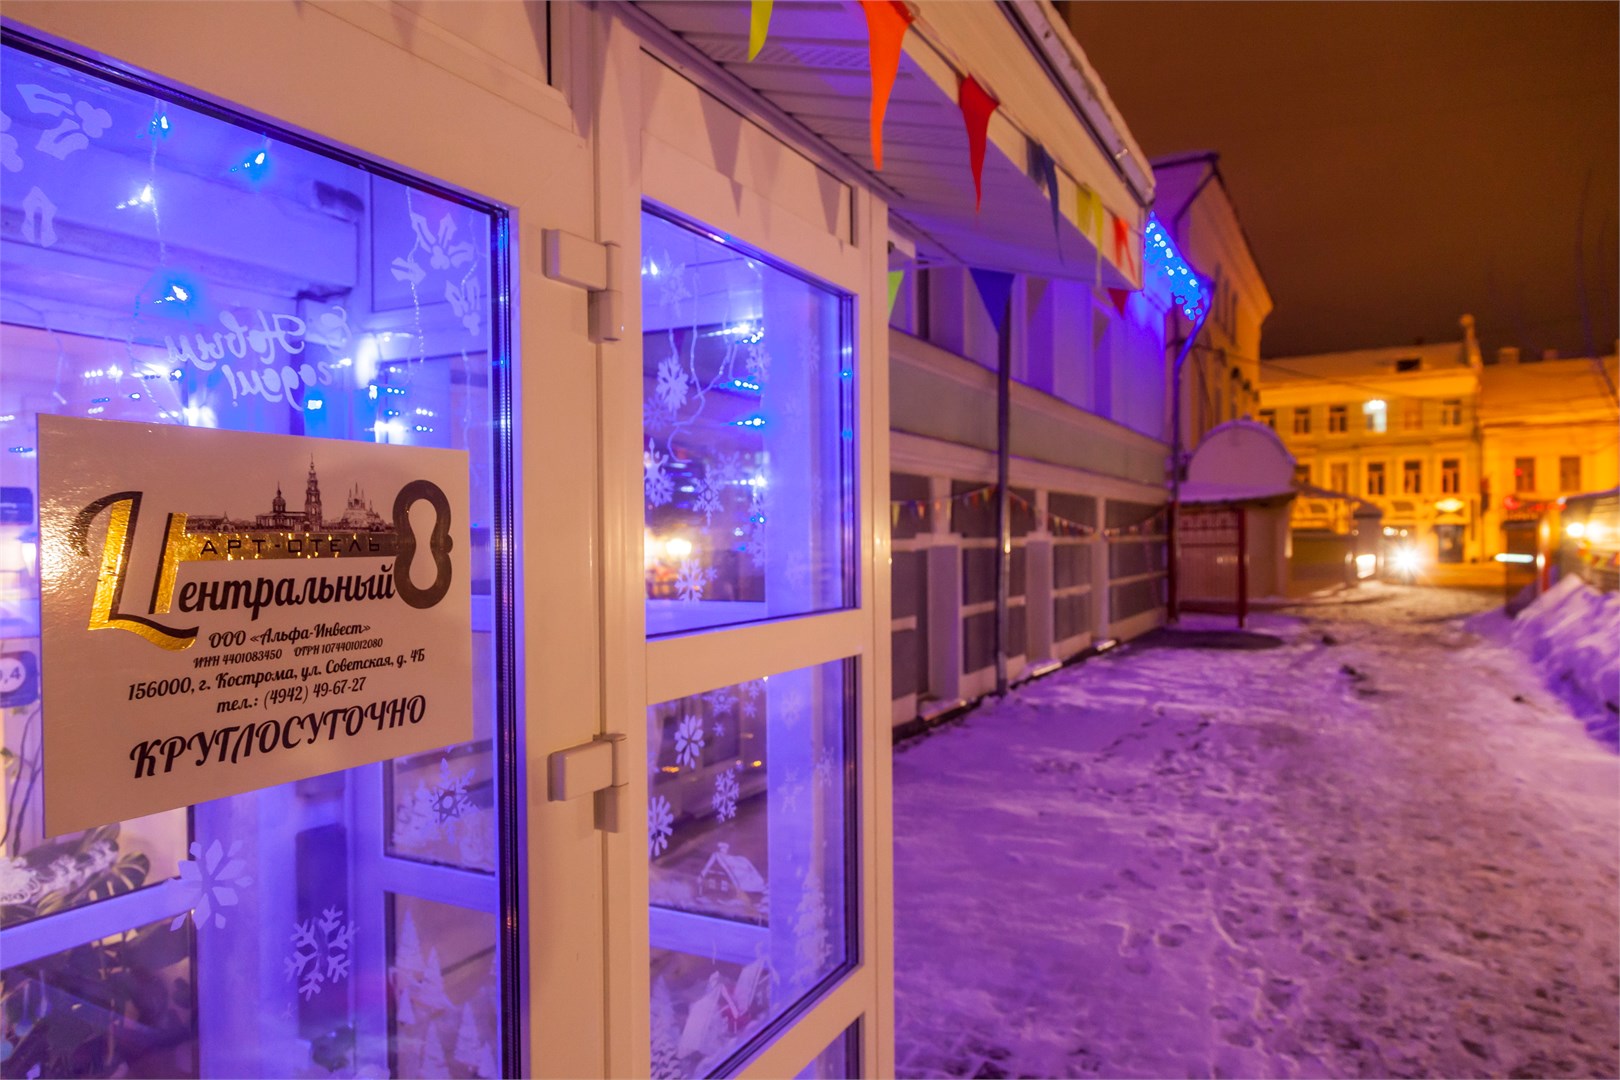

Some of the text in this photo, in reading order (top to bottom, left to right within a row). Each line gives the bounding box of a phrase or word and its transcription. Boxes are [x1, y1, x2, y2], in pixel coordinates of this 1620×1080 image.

[200, 539, 380, 555] АРТ-ОТЕЛЬ
[68, 490, 396, 652] Центральный
[192, 637, 384, 669] ИНН 4401083450 ОГРН 1074401012080
[208, 621, 372, 649] ООО «Альфа-Инвест»
[127, 647, 426, 701] 156000, г. Кострома, ул. Советская, д. 4Б
[216, 676, 368, 713] тел.: (4942) 49-67-27
[129, 694, 427, 779] КРУГЛОСУТОЧНО
